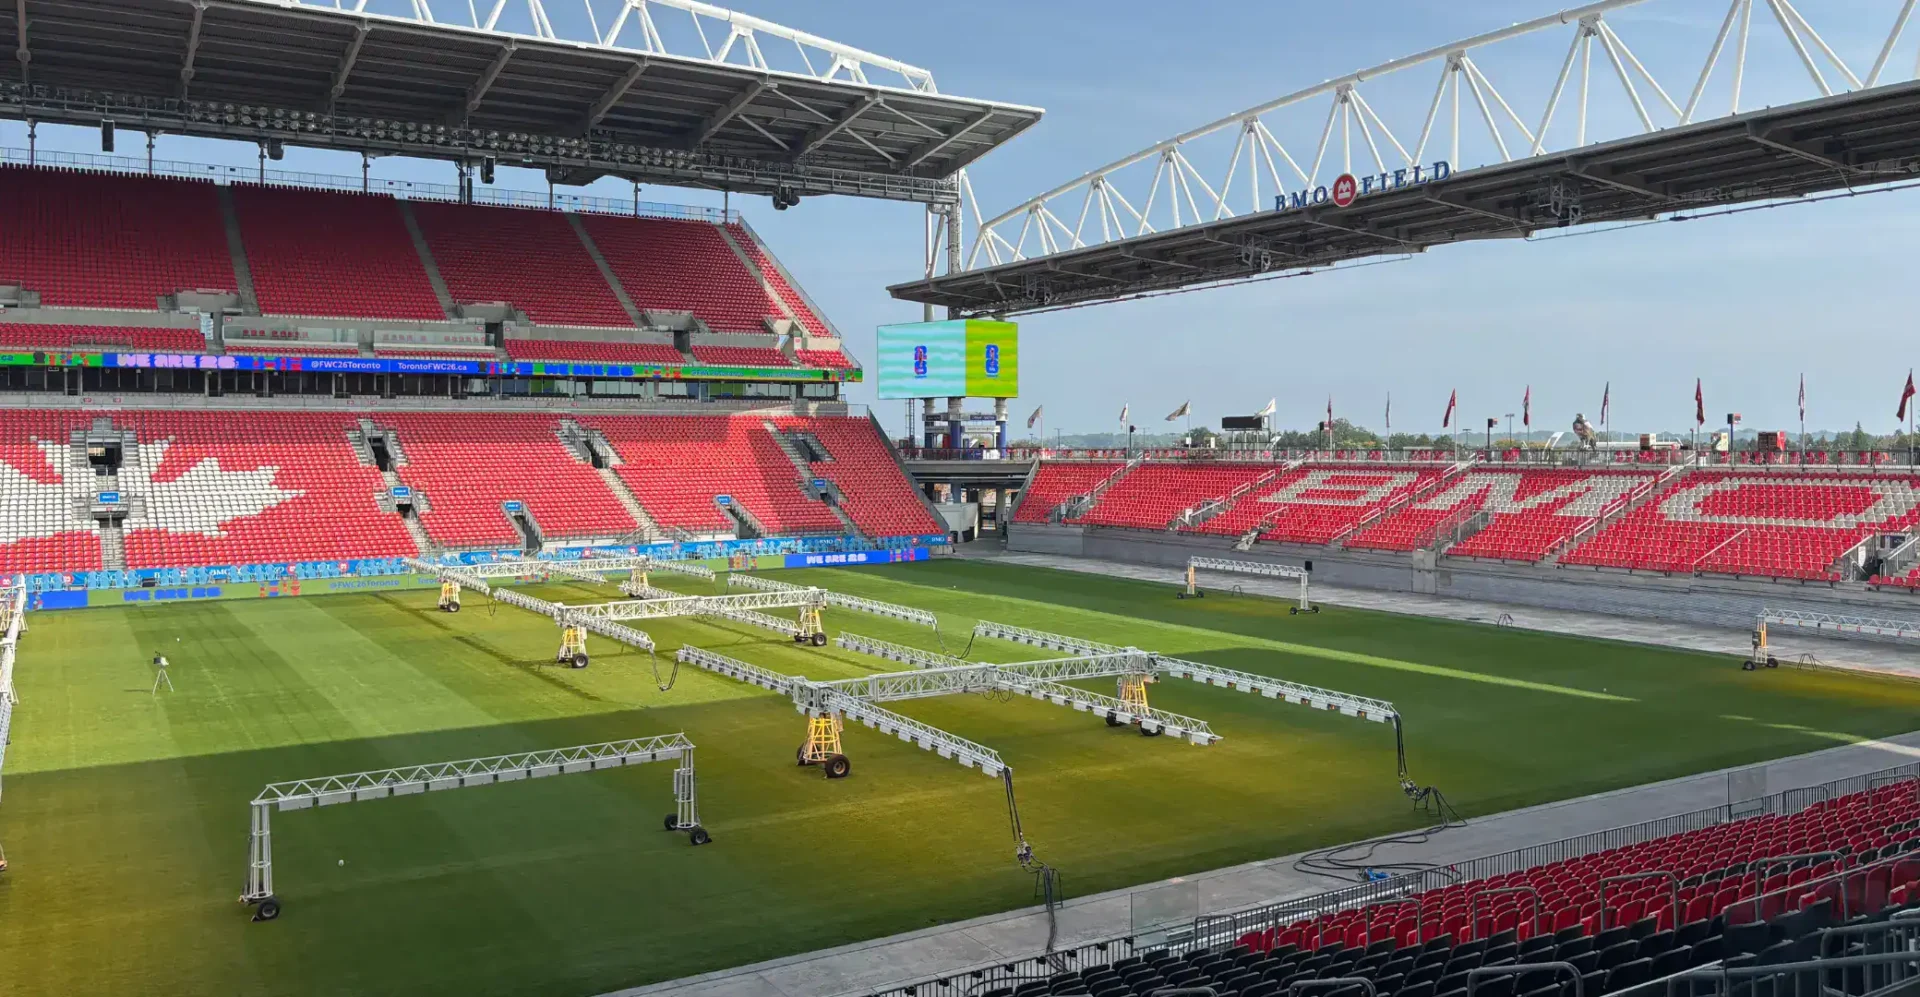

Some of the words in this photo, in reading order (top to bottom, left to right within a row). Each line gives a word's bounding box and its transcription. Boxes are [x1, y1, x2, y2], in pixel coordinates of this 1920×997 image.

[1275, 186, 1328, 212] BMO
[1361, 161, 1452, 195] FIELD
[311, 361, 381, 370] @FWC26Toronto
[398, 362, 467, 371] TorontoFWC26.ca
